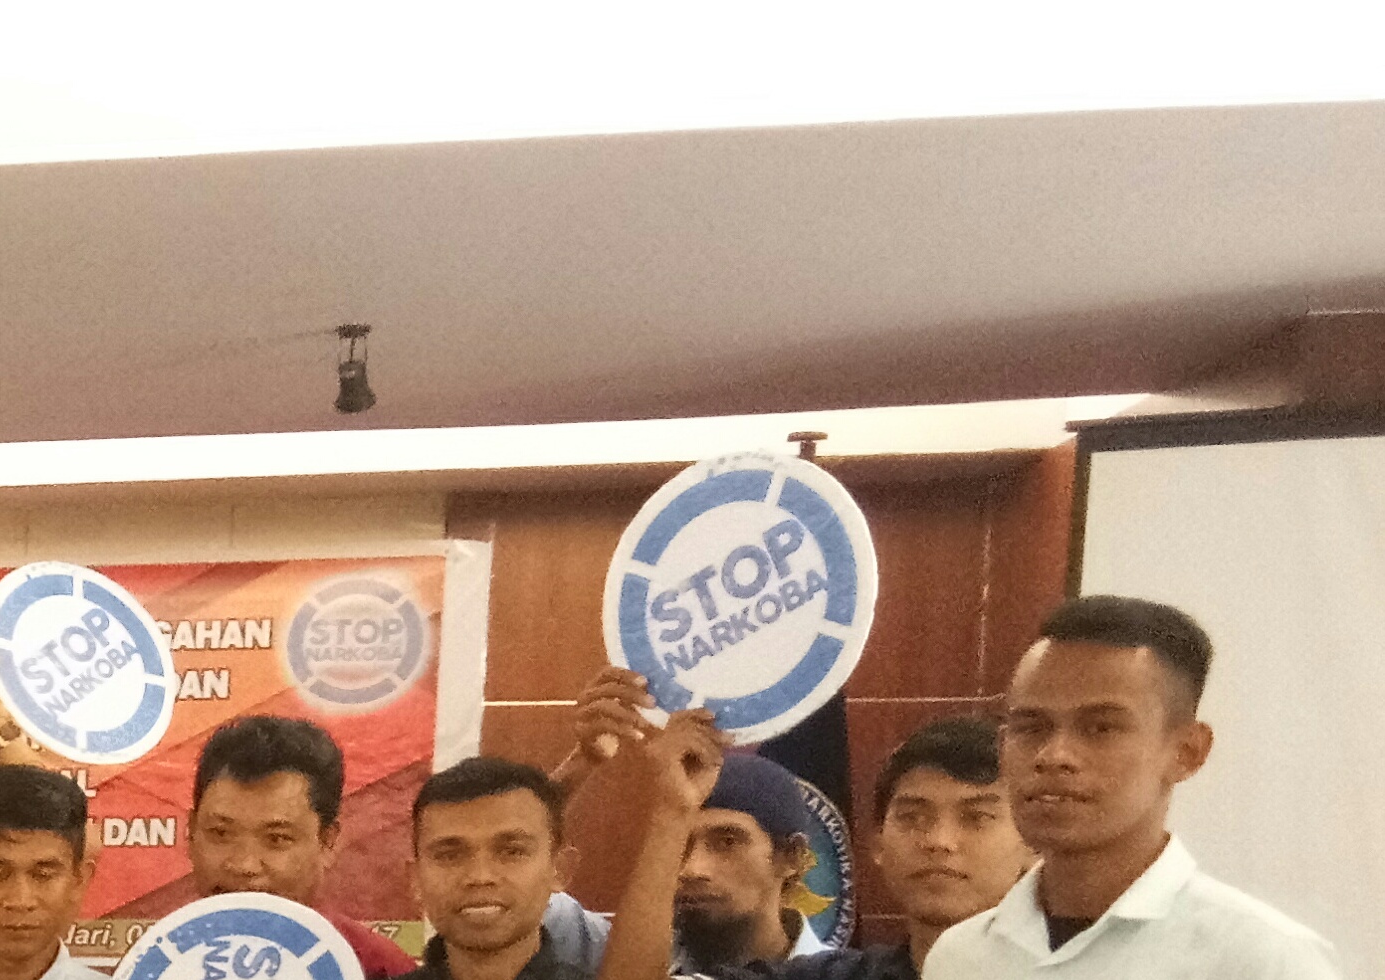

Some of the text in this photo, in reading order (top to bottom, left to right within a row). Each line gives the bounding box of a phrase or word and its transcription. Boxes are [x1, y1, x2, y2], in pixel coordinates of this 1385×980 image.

[652, 520, 805, 639] STOP
[20, 609, 110, 693] STOP
[305, 647, 402, 661] NARKOBA
[311, 619, 404, 644] STOP
[665, 571, 828, 676] NARKOBA
[44, 641, 138, 716] NARKOBA
[104, 818, 176, 846] DAN
